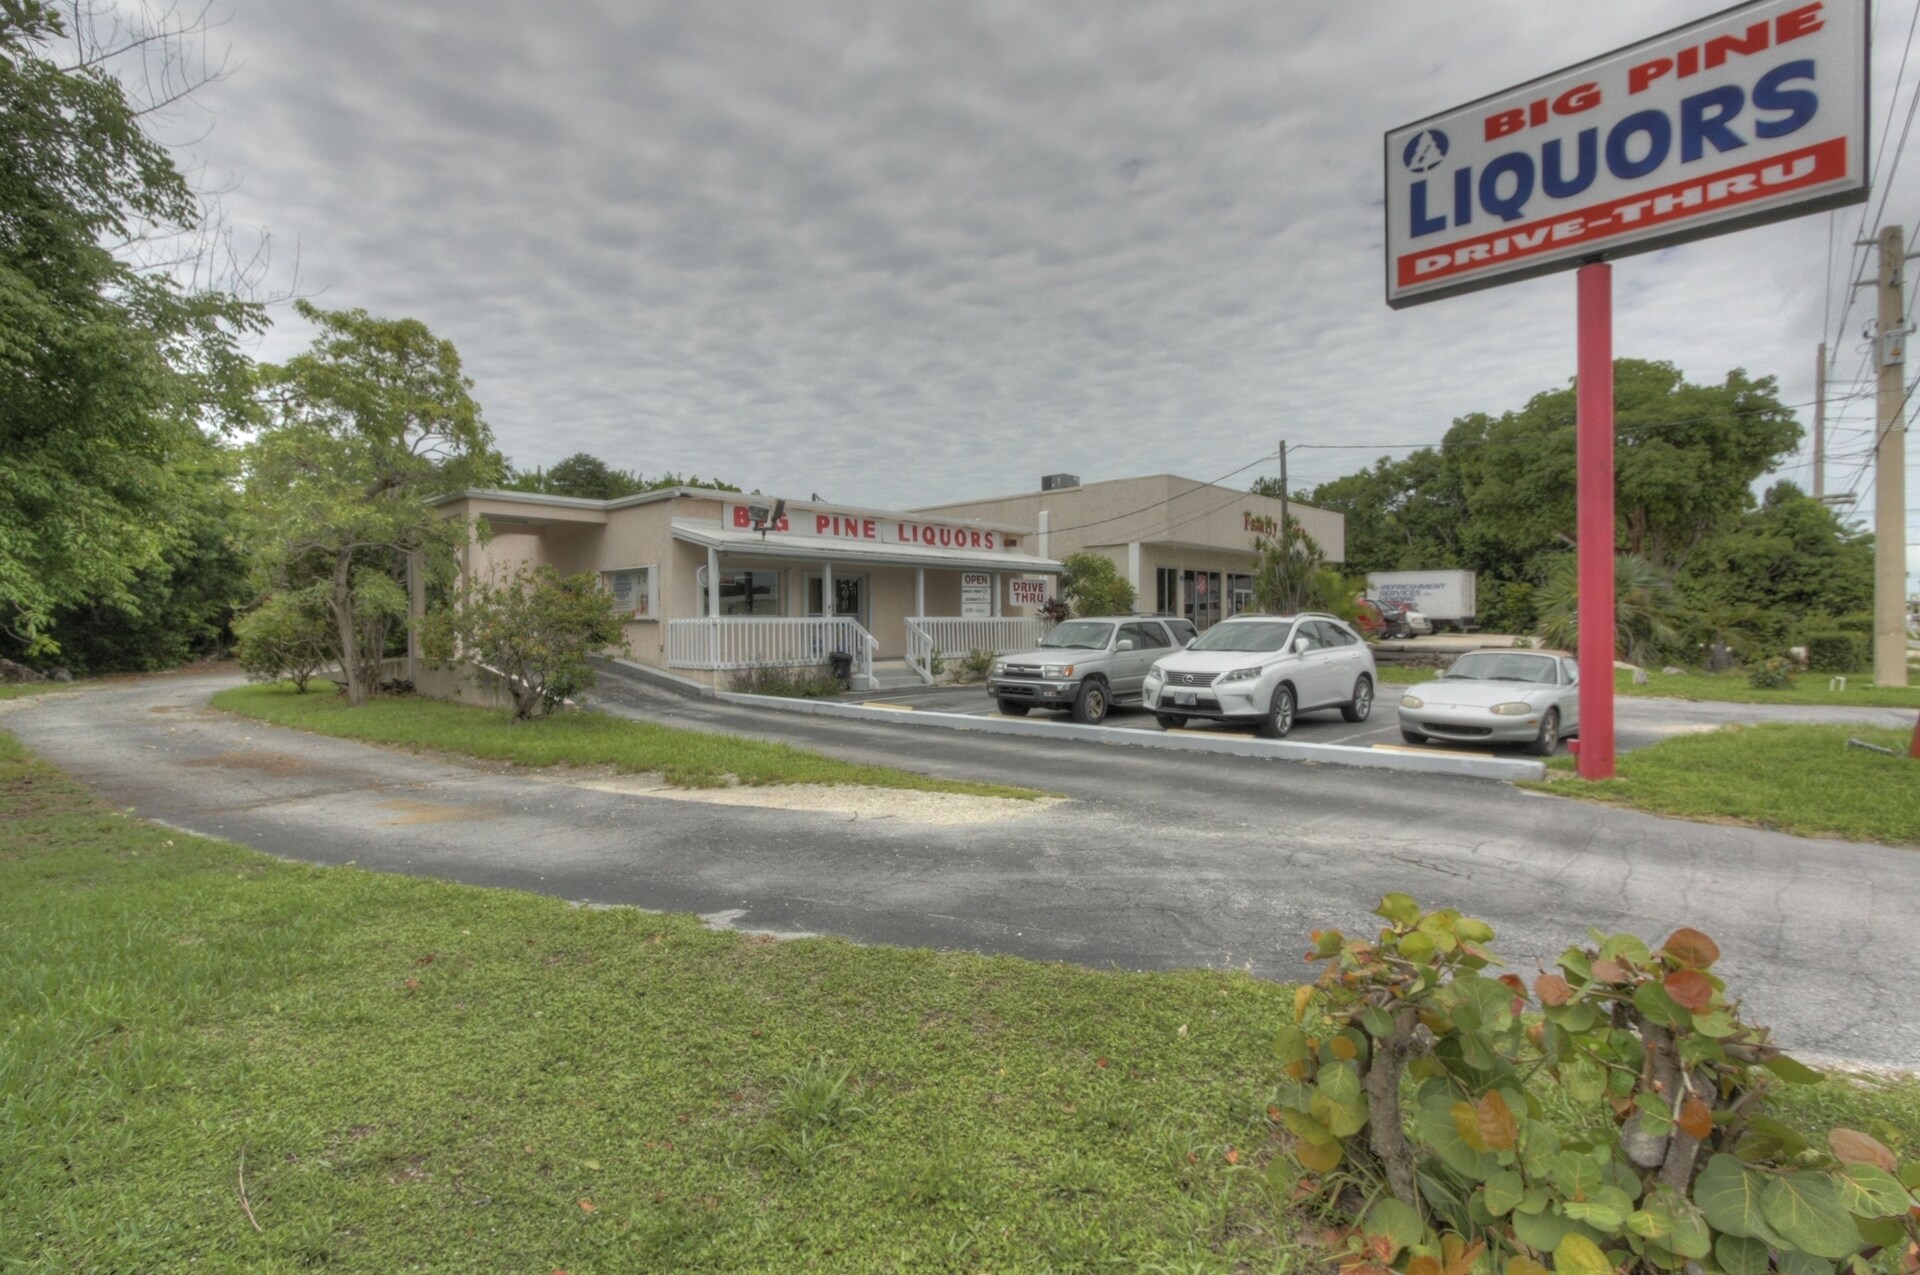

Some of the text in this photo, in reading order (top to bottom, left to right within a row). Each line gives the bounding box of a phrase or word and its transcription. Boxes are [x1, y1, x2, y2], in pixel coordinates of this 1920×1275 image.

[1484, 1, 1826, 142] BIG PINE
[1410, 59, 1819, 239] LIQUORS
[1414, 154, 1817, 276] DRIVE-THRU
[816, 514, 876, 539] PINE
[898, 523, 994, 550] LIQUORS
[965, 574, 988, 585] OPEN
[1013, 581, 1044, 593] DRIVE
[1015, 592, 1044, 603] THRU
